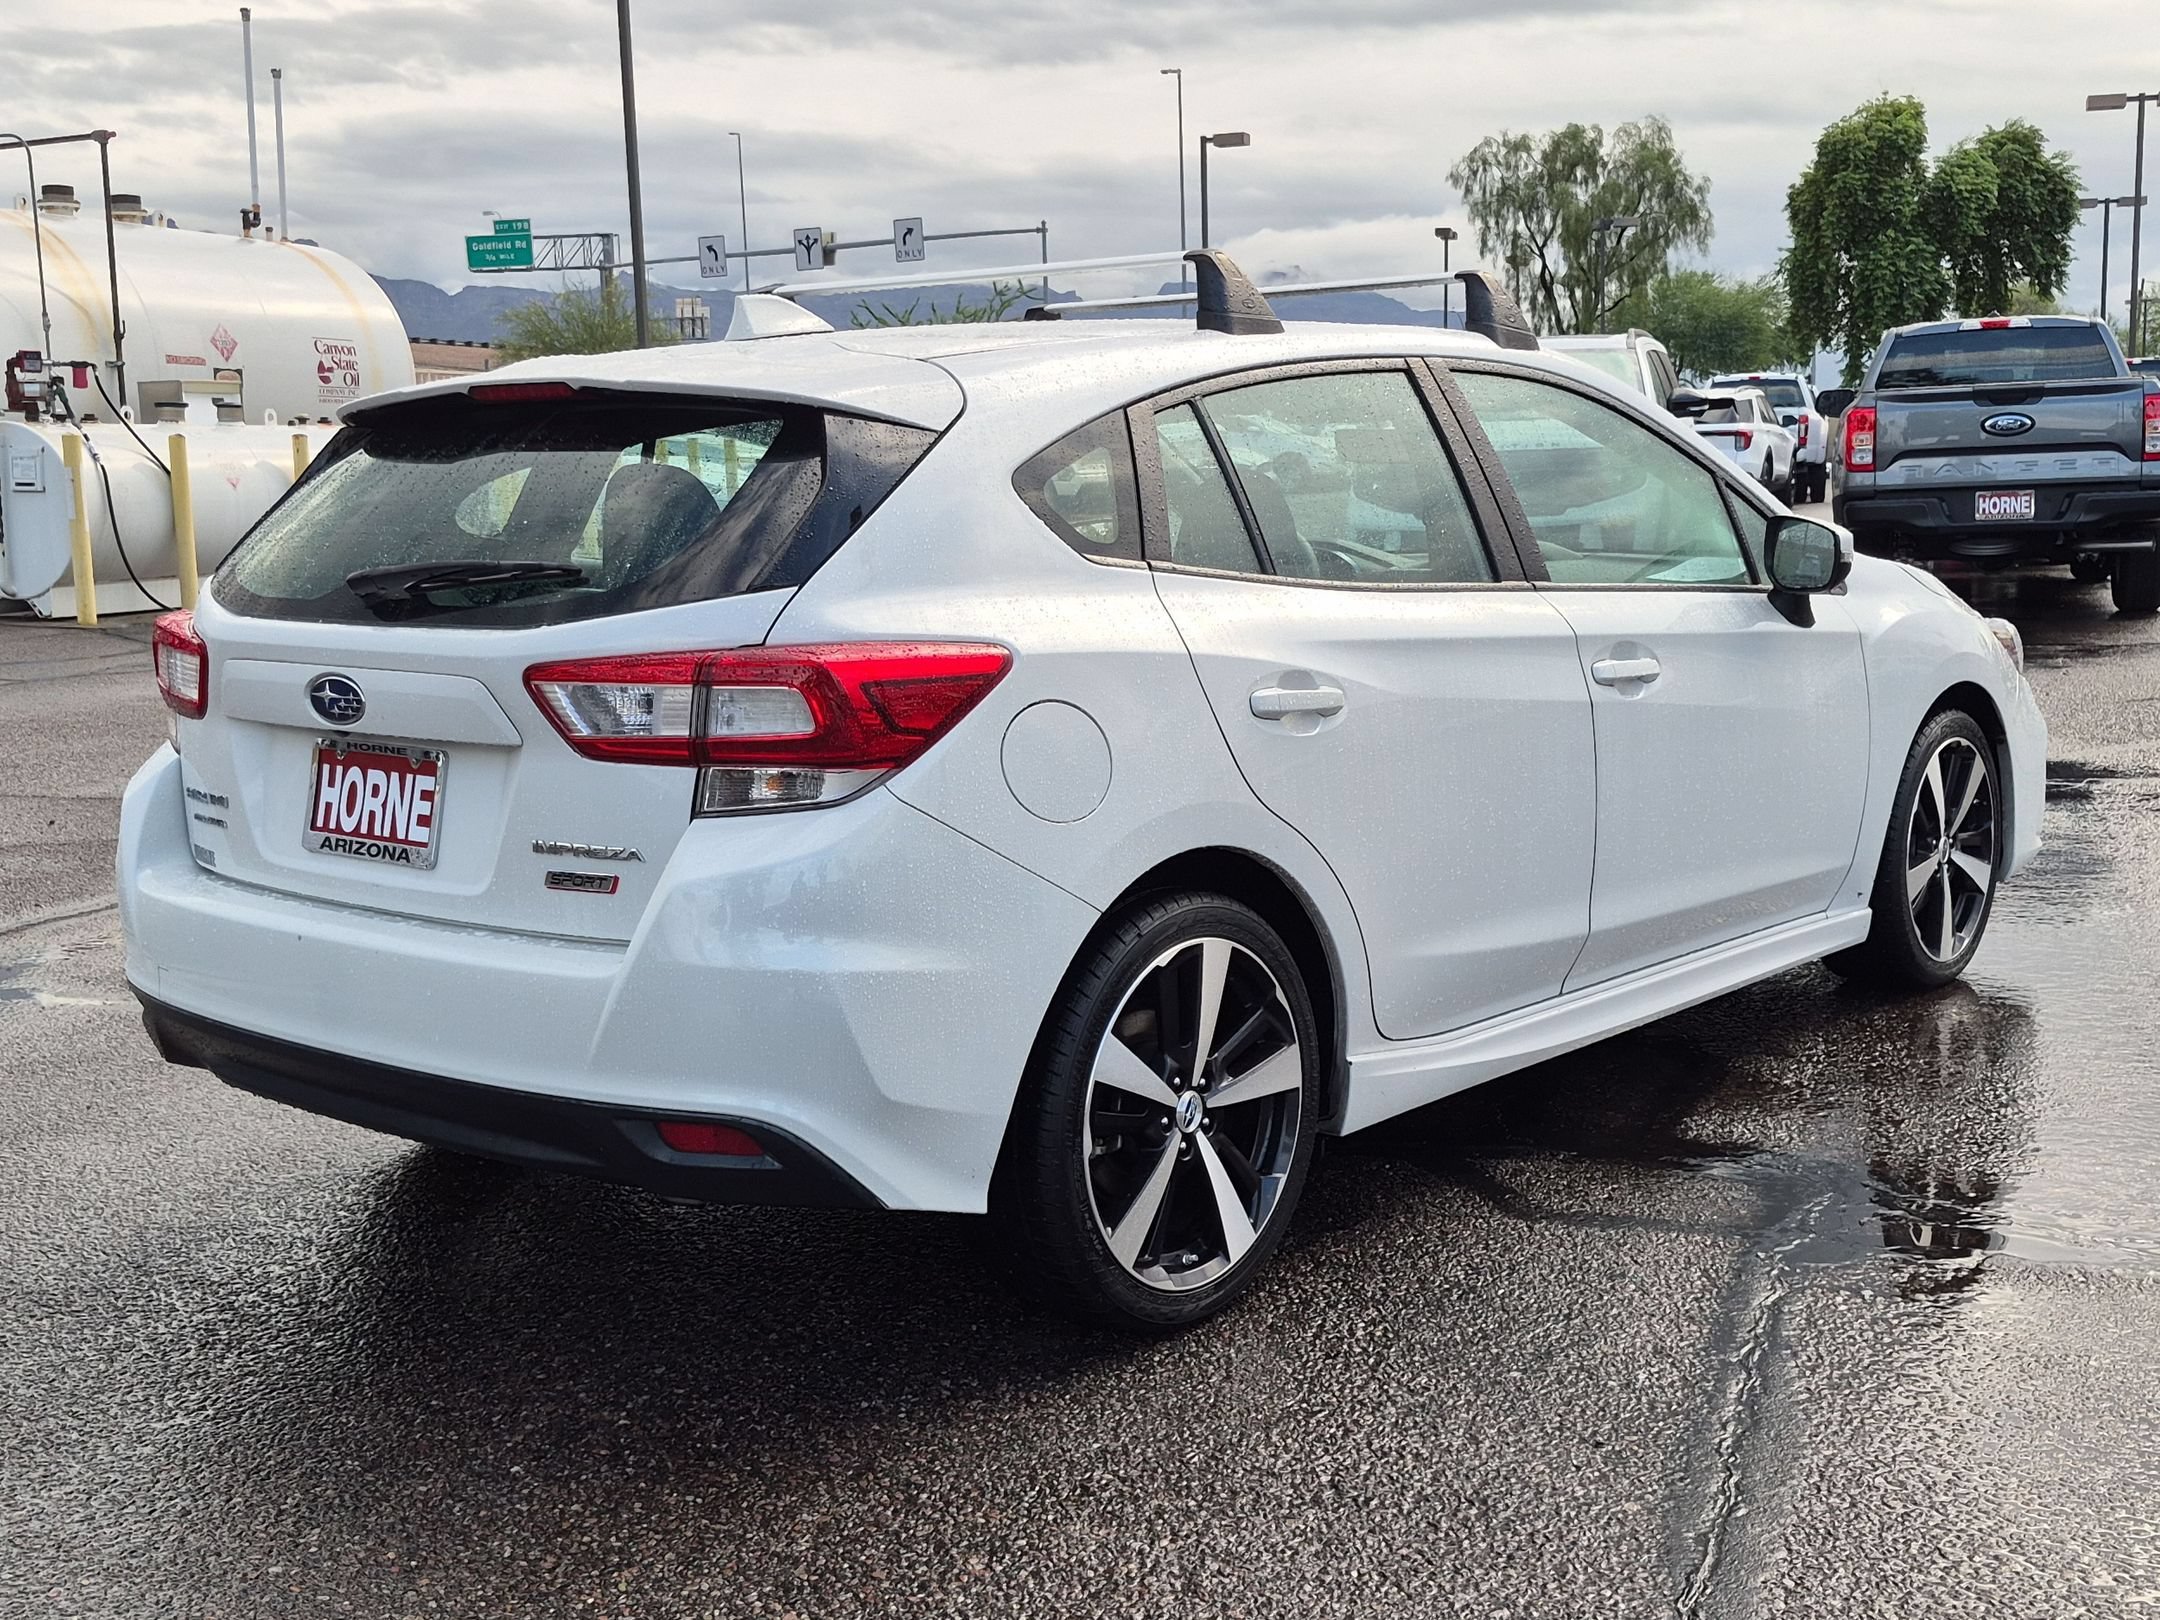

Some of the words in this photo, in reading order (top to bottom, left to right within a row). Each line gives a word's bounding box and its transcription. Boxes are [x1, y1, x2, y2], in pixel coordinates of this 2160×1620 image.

[472, 240, 512, 251] Goldfield
[515, 240, 527, 249] Rd
[897, 249, 922, 259] ONLY
[702, 265, 725, 275] ONLY
[314, 339, 357, 359] Canyon
[331, 355, 358, 371] State
[343, 371, 360, 387] Oil
[1899, 457, 2122, 478] RANGER
[1979, 495, 2031, 514] HORNE
[346, 741, 408, 756] HORNE
[316, 763, 436, 843] HORNE
[319, 836, 411, 864] ARIZONA
[531, 839, 647, 863] IMPREZA
[550, 873, 609, 889] SPORT
